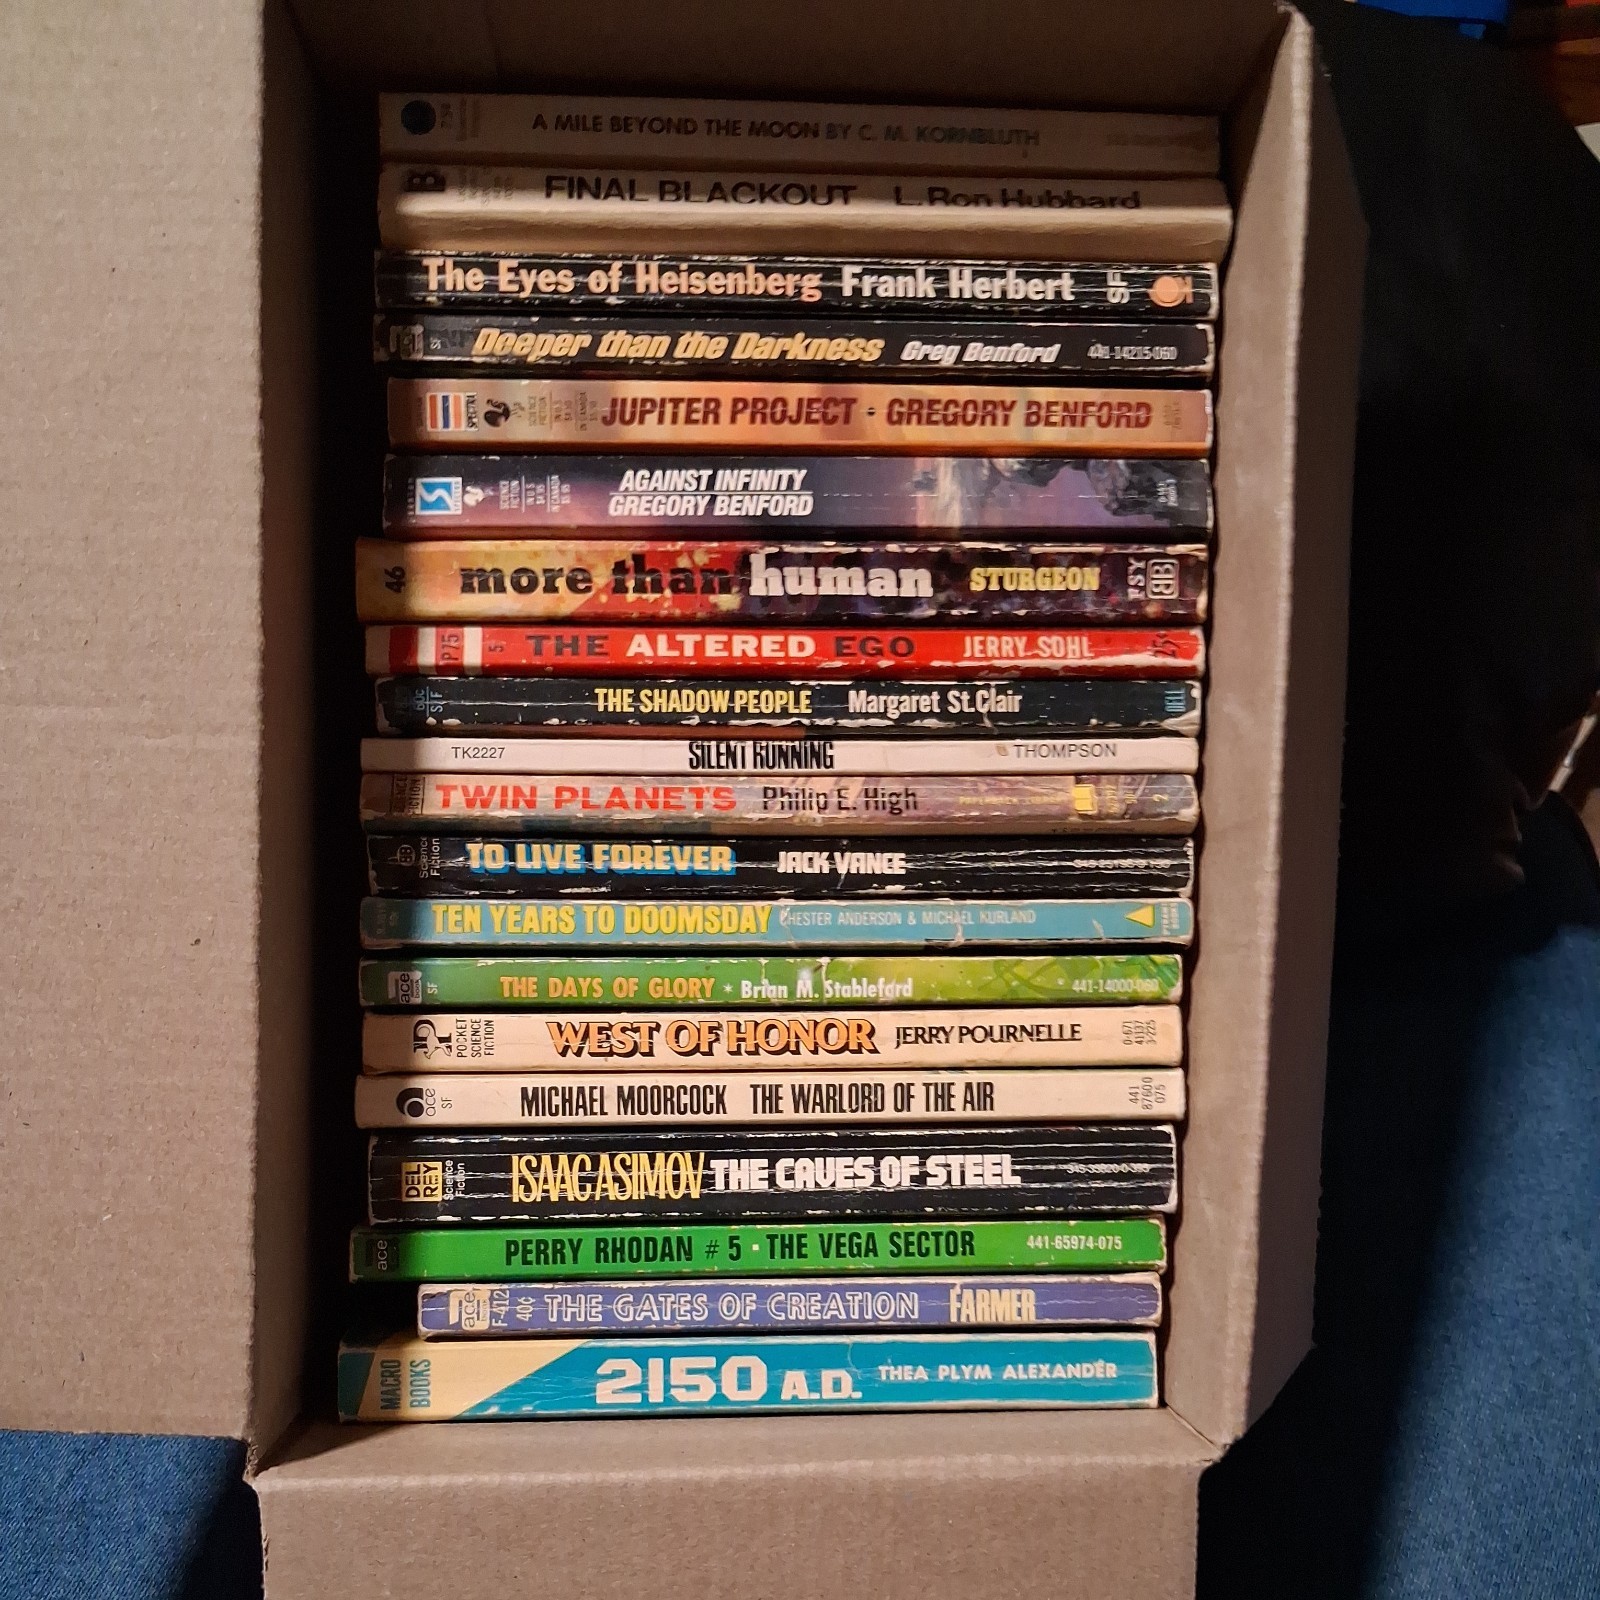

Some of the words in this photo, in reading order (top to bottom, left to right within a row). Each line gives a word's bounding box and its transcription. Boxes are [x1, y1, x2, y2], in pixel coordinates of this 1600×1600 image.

[532, 113, 548, 132] A
[554, 114, 603, 133] MILE
[610, 115, 698, 135] BEYOND
[706, 118, 743, 137] THE
[748, 119, 820, 139] MOON
[825, 123, 852, 140] BY
[858, 123, 873, 141] C.
[884, 125, 907, 143] M.
[916, 126, 1040, 146] KORNBLUTH
[544, 175, 650, 202] FINAL
[659, 179, 858, 206] BLACKOUT
[1001, 187, 1140, 211] Hubbard
[422, 258, 485, 293] The
[498, 259, 575, 299] Eyes
[587, 259, 624, 294] of
[634, 261, 823, 303] Heisenberg
[841, 265, 937, 298] Frank
[949, 267, 1076, 302] Herbert
[1107, 270, 1130, 304] SF
[471, 327, 593, 364] Deeper
[597, 330, 673, 360] than
[673, 331, 728, 361] the
[731, 331, 885, 363] Darkness
[900, 341, 961, 366] Greg
[962, 342, 1062, 364] Benford
[466, 392, 478, 432] SPECTRA
[539, 396, 548, 426] FICTION
[601, 397, 723, 427] JUPITER
[729, 398, 857, 427] PROJECT
[886, 399, 1018, 427] GREGORY
[1023, 400, 1153, 428] BENFORD
[510, 480, 520, 509] FICTION
[618, 469, 713, 492] AGAINST
[713, 469, 808, 491] INFINITY
[608, 495, 711, 517] GREGORY
[713, 495, 814, 517] BENFORD
[384, 566, 406, 593] 46
[460, 566, 594, 595] more
[611, 553, 733, 596] than
[748, 553, 934, 597] human
[969, 567, 1101, 592] STURGEON
[525, 635, 609, 657] THE
[626, 634, 816, 658] ALTERED
[834, 636, 915, 658] EGO
[962, 636, 1028, 659] JERRY
[1037, 636, 1094, 659] SOHL
[595, 687, 635, 712] THE
[639, 689, 731, 714] SHADOW
[733, 690, 812, 714] PEOPLE
[848, 690, 941, 719] Margaret
[1164, 686, 1186, 713] DELL
[450, 745, 506, 760] TK2227
[688, 740, 748, 769] SILENT
[752, 740, 835, 770] RUNNING
[1013, 743, 1117, 760] THOMPSON
[435, 784, 538, 811] TWIN
[554, 785, 738, 811] PLANETS
[762, 786, 828, 813] Philip
[836, 787, 857, 812] E.
[864, 786, 919, 815] High
[430, 837, 441, 877] Fiction
[465, 842, 510, 875] TO
[514, 843, 585, 875] LIVE
[593, 844, 737, 876] FOREVER
[777, 851, 832, 874] JACK
[834, 852, 907, 875] VANCE
[432, 905, 482, 934] TEN
[490, 904, 576, 934] YEARS
[583, 905, 615, 934] TO
[624, 904, 773, 934] DOOMSDAY
[779, 908, 833, 927] CHESTER
[837, 910, 902, 926] ANDERSON
[907, 911, 917, 926] &
[922, 910, 975, 926] MICHAEL
[979, 909, 1037, 925] KURLAND
[400, 972, 410, 1003] ace
[427, 982, 438, 995] SF
[500, 976, 539, 998] THE
[549, 976, 604, 998] DAYS
[612, 976, 639, 998] OF
[648, 975, 715, 999] GLORY
[741, 977, 788, 999] Brian
[797, 979, 820, 999] M.
[825, 976, 914, 999] Stableford
[456, 1018, 468, 1058] POCKET
[471, 1018, 482, 1058] SCIENCE
[484, 1019, 494, 1056] FICTION
[546, 1020, 659, 1058] WEST
[665, 1020, 726, 1056] OF
[727, 1018, 880, 1056] HONOR
[894, 1025, 952, 1050] JERRY
[958, 1023, 1083, 1045] POURNELLE
[1123, 1020, 1133, 1046] 0-671
[1135, 1020, 1145, 1046] 41137
[425, 1087, 437, 1117] ace
[442, 1096, 453, 1110] SF
[520, 1085, 609, 1117] MICHAEL
[616, 1084, 728, 1116] MOORCOCK
[750, 1083, 784, 1115] THE
[791, 1082, 885, 1114] WARLORD
[893, 1082, 921, 1113] OF
[922, 1081, 956, 1112] THE
[963, 1081, 995, 1112] AIR
[1128, 1085, 1140, 1105] 441
[1142, 1076, 1153, 1111] 87600
[1155, 1083, 1165, 1104] 075
[405, 1162, 422, 1199] DEL
[424, 1162, 441, 1199] REY
[443, 1159, 453, 1201] Science
[455, 1162, 465, 1199] Fiction
[511, 1153, 593, 1203] ISAAC
[594, 1152, 705, 1201] ASIMOV
[710, 1159, 769, 1191] THE
[775, 1156, 874, 1190] CAVES
[879, 1155, 922, 1188] OF
[926, 1154, 1022, 1187] STEEL
[376, 1239, 388, 1271] ace
[505, 1237, 584, 1267] PERRY
[594, 1235, 693, 1264] RHODAN
[704, 1238, 720, 1260] #
[728, 1235, 742, 1262] 5
[766, 1232, 808, 1260] THE
[818, 1231, 879, 1259] VEGA
[888, 1230, 976, 1258] SECTOR
[1026, 1235, 1123, 1251] 441-65974-075
[462, 1291, 476, 1329] ace
[492, 1290, 510, 1327] F-412
[543, 1294, 603, 1323] THE
[612, 1292, 710, 1322] GATES
[719, 1292, 757, 1321] OF
[766, 1291, 920, 1321] CREATION
[949, 1286, 1036, 1323] FARMER
[380, 1359, 402, 1411] MACRO
[409, 1358, 431, 1408] BOOKS
[596, 1354, 768, 1404] 2150
[780, 1369, 863, 1400] A.D.
[877, 1363, 929, 1381] THEA
[938, 1364, 993, 1380] PLYM
[1002, 1361, 1118, 1380] ALEXANDER
